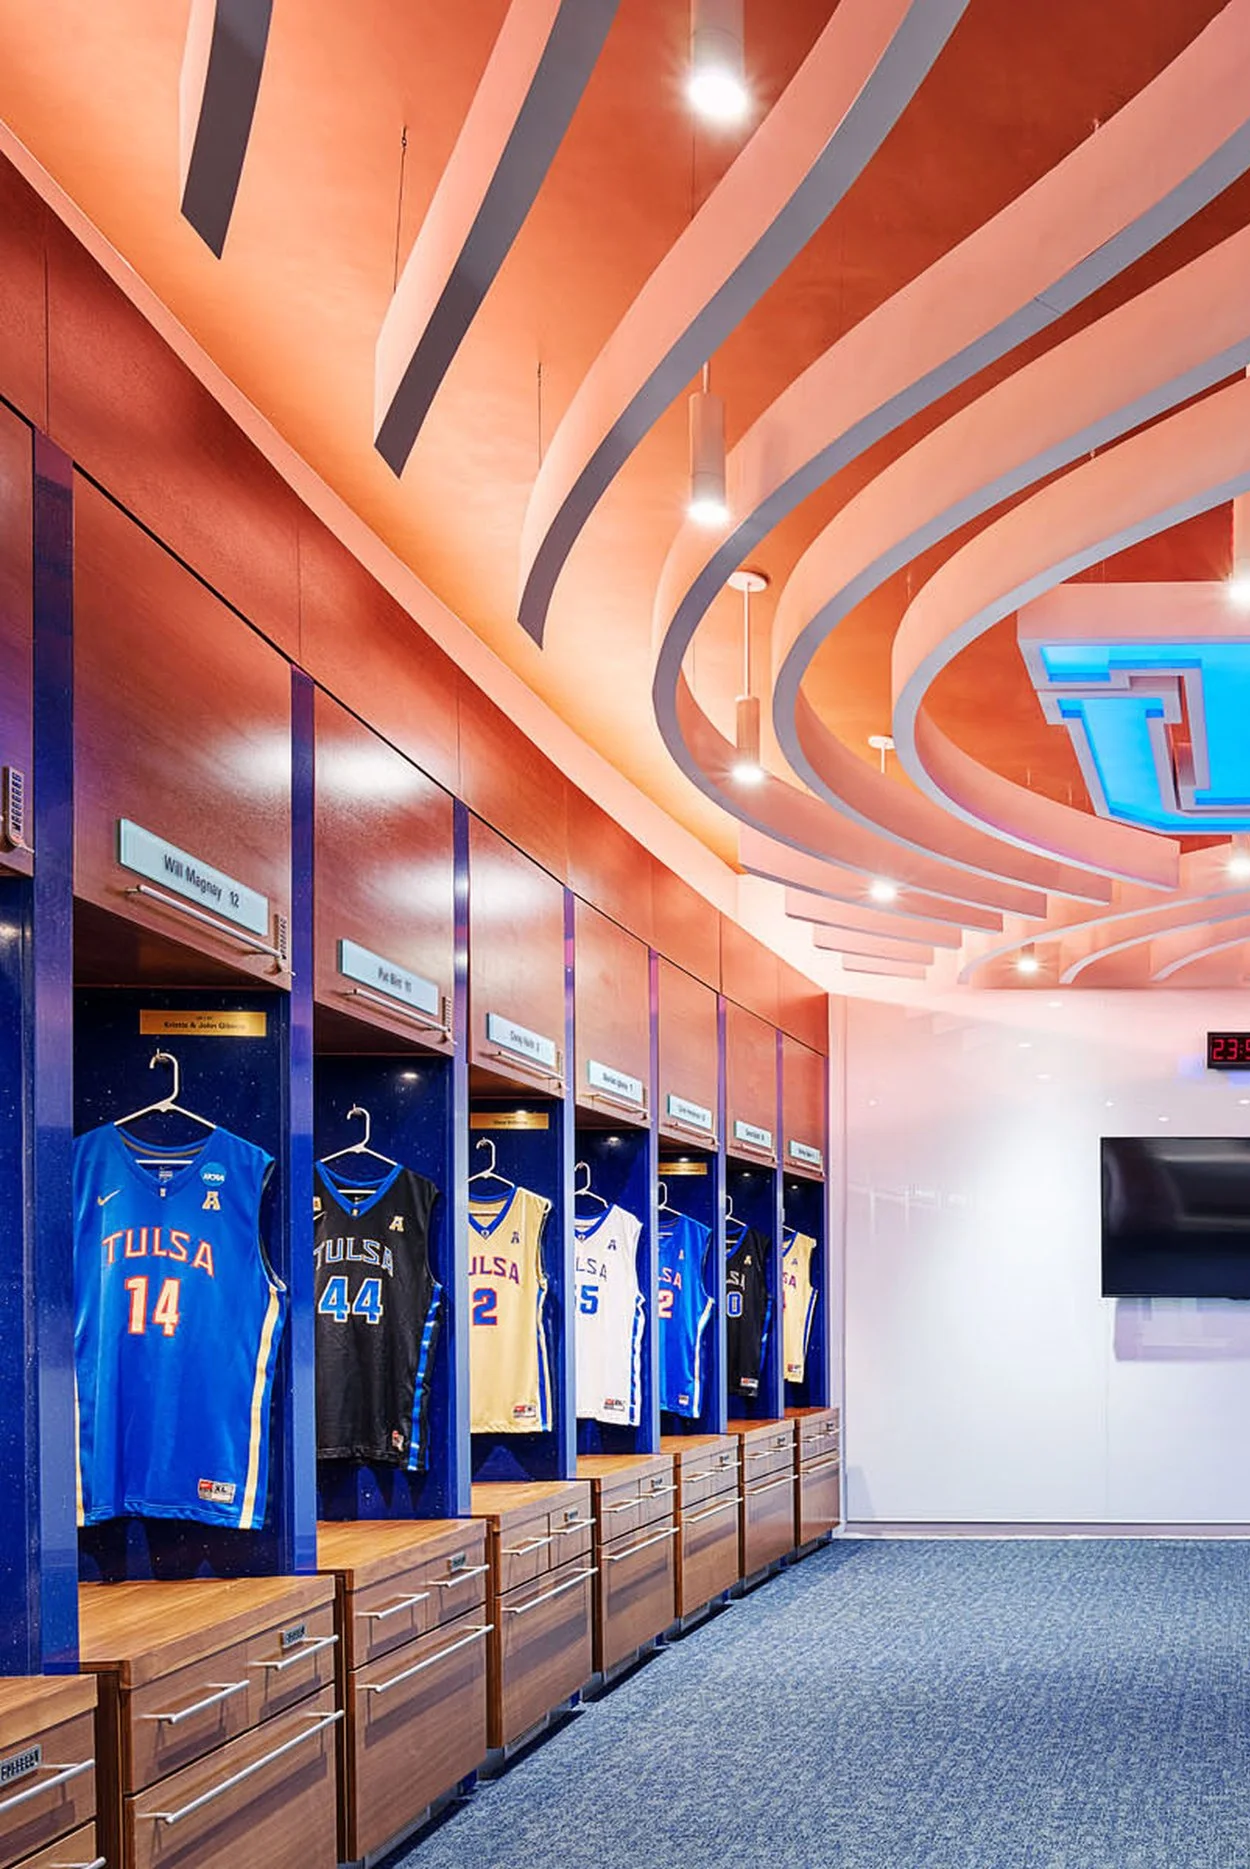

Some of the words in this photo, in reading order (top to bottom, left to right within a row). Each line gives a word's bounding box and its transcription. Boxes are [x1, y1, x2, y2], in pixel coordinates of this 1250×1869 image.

[164, 854, 183, 878] Will
[186, 866, 222, 901] Magnay
[229, 890, 240, 908] 12
[101, 1227, 215, 1278] TULSA
[124, 1275, 181, 1337] 14
[318, 1275, 384, 1325] 44
[472, 1287, 498, 1326] 2
[576, 1284, 599, 1315] 5
